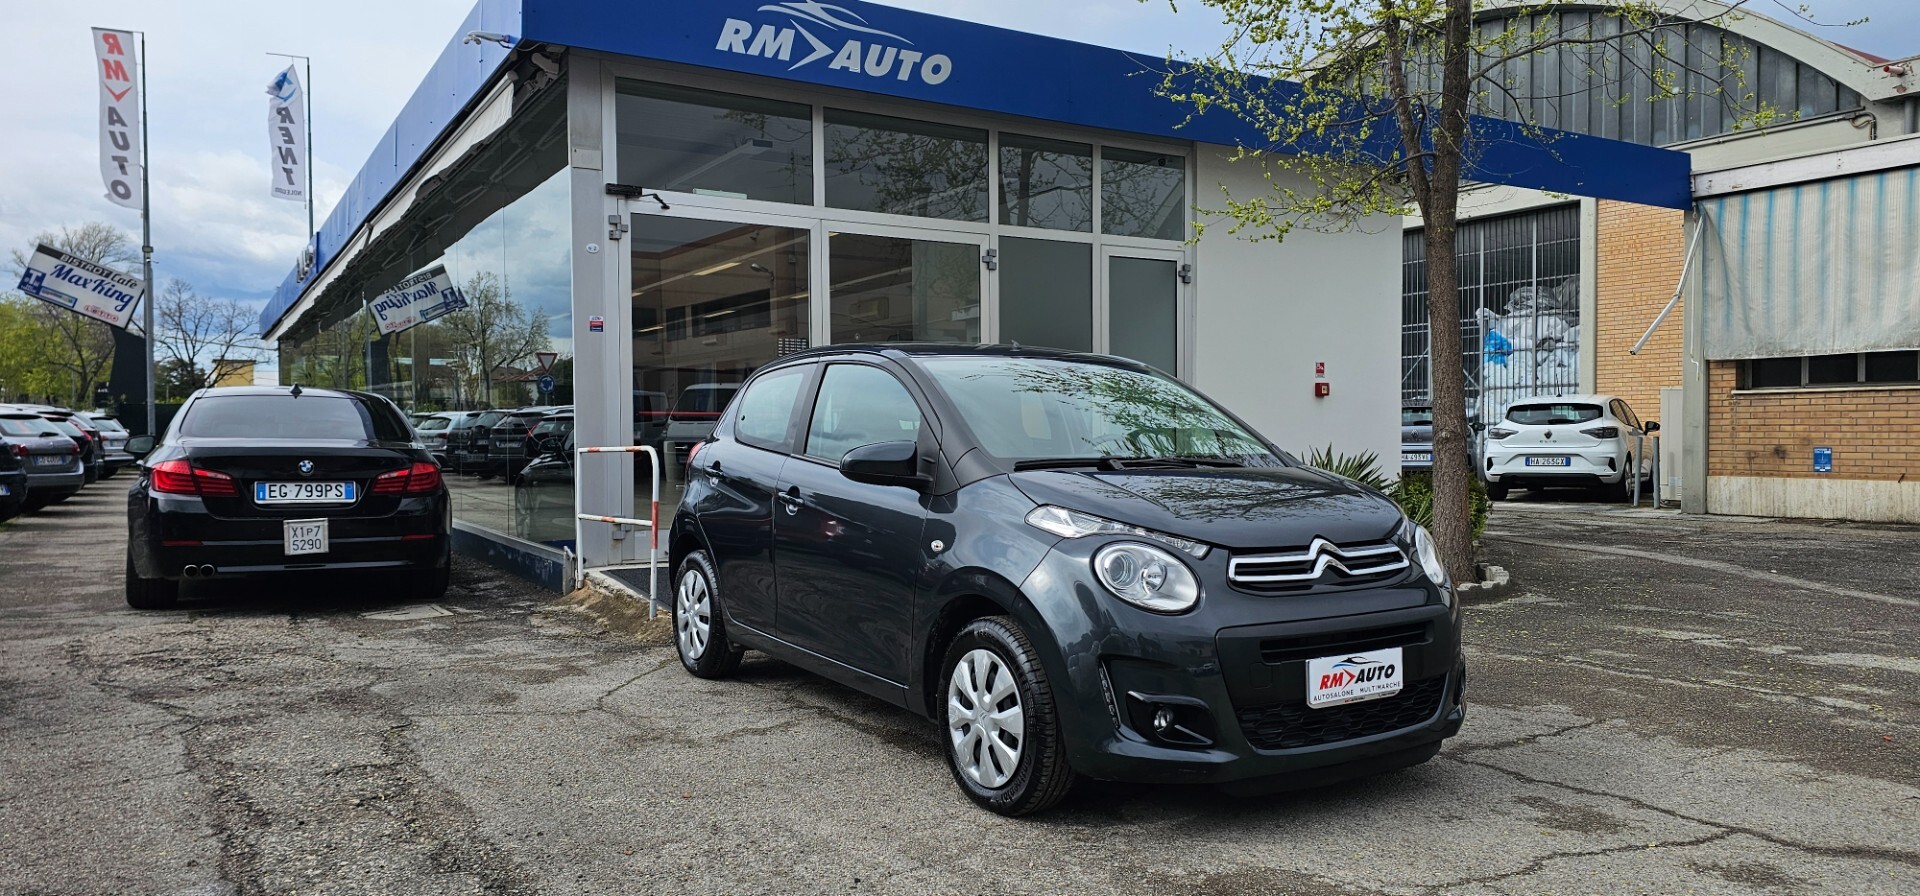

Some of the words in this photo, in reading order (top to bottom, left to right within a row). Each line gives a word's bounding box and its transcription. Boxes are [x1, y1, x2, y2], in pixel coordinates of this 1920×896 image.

[715, 17, 796, 62] RM
[828, 39, 953, 86] AUTO
[60, 253, 110, 279] BISTROT
[110, 273, 138, 290] Café
[50, 263, 92, 289] Max
[91, 279, 135, 313] King
[268, 484, 288, 498] EG
[294, 484, 343, 498] 799PS
[292, 539, 322, 551] 5290
[1319, 671, 1344, 690] RM
[1354, 664, 1396, 684] AUTO
[1313, 689, 1355, 702] AUTOSALONE
[1359, 680, 1401, 693] MULTIMARCHE
